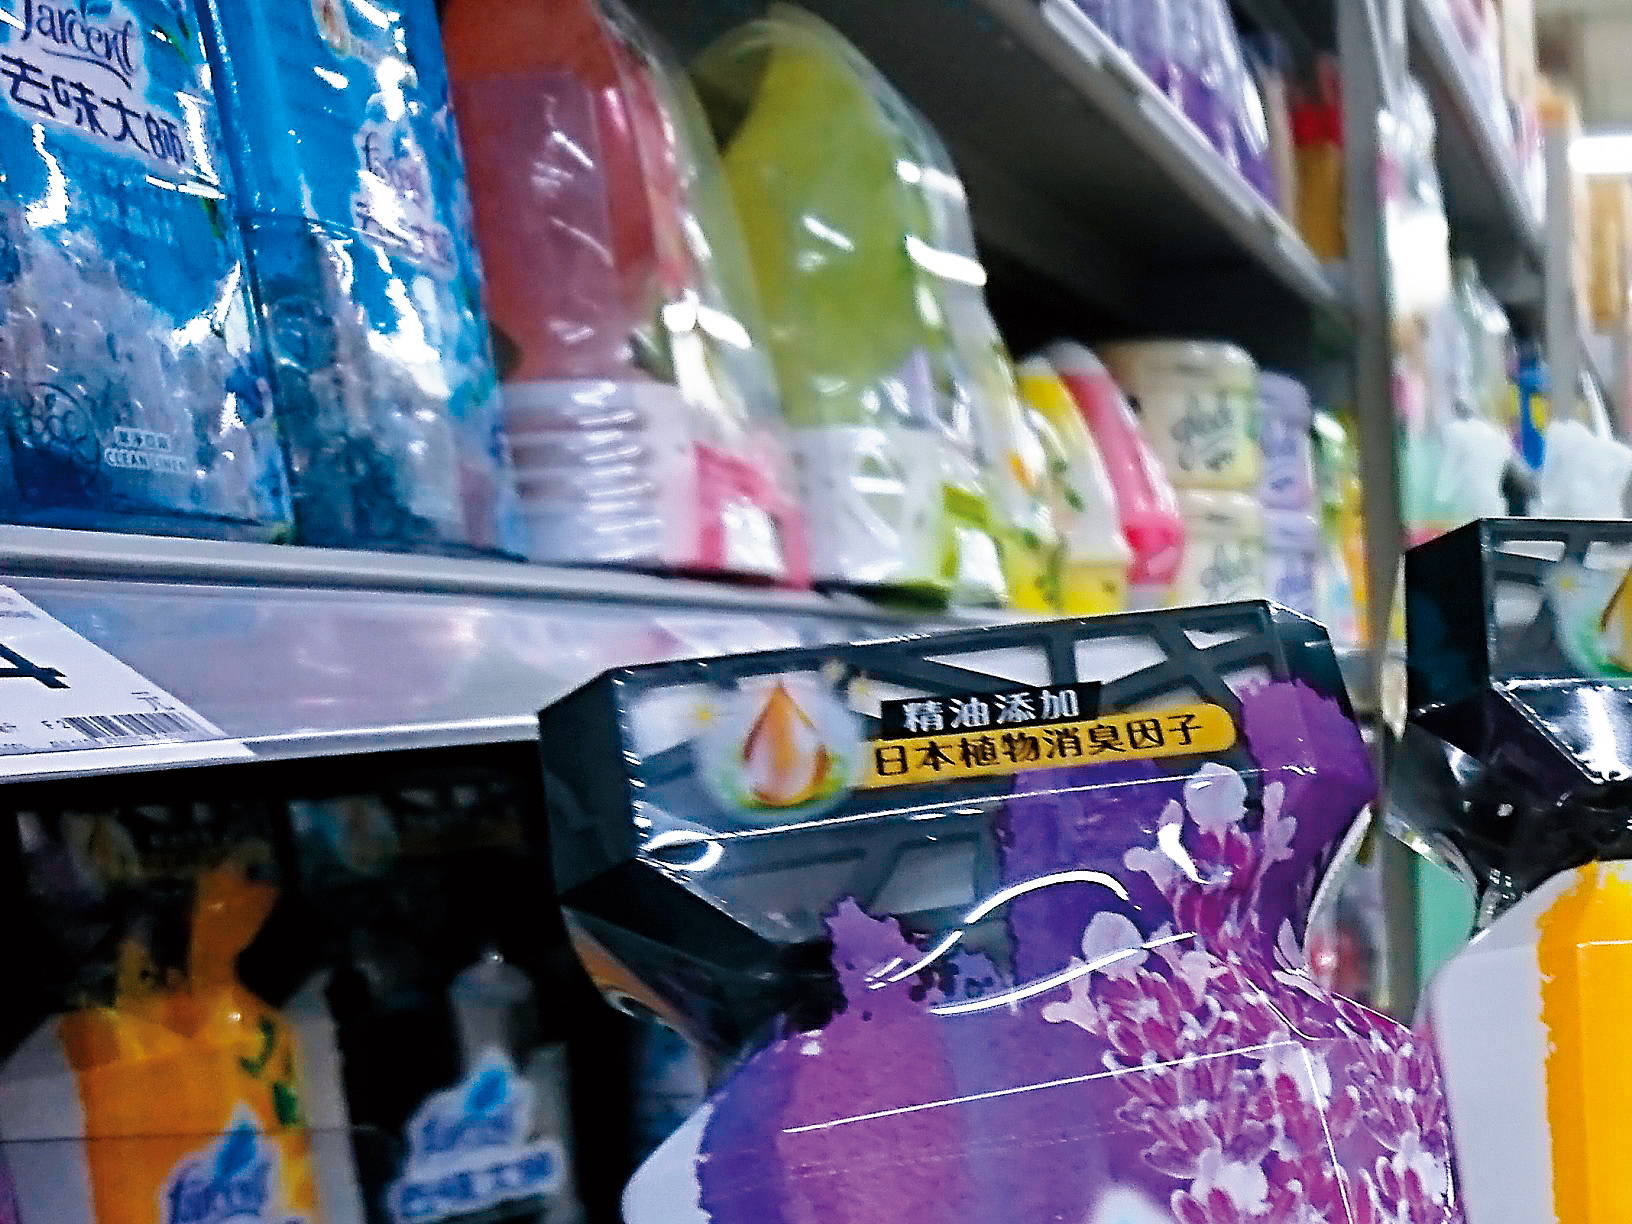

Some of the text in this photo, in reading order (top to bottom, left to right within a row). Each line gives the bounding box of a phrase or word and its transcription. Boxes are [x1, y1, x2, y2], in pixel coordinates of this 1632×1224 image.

[2, 54, 186, 164] 去味大師
[903, 689, 1081, 734] 精油添加
[875, 713, 1204, 777] 日本植物消臭因子
